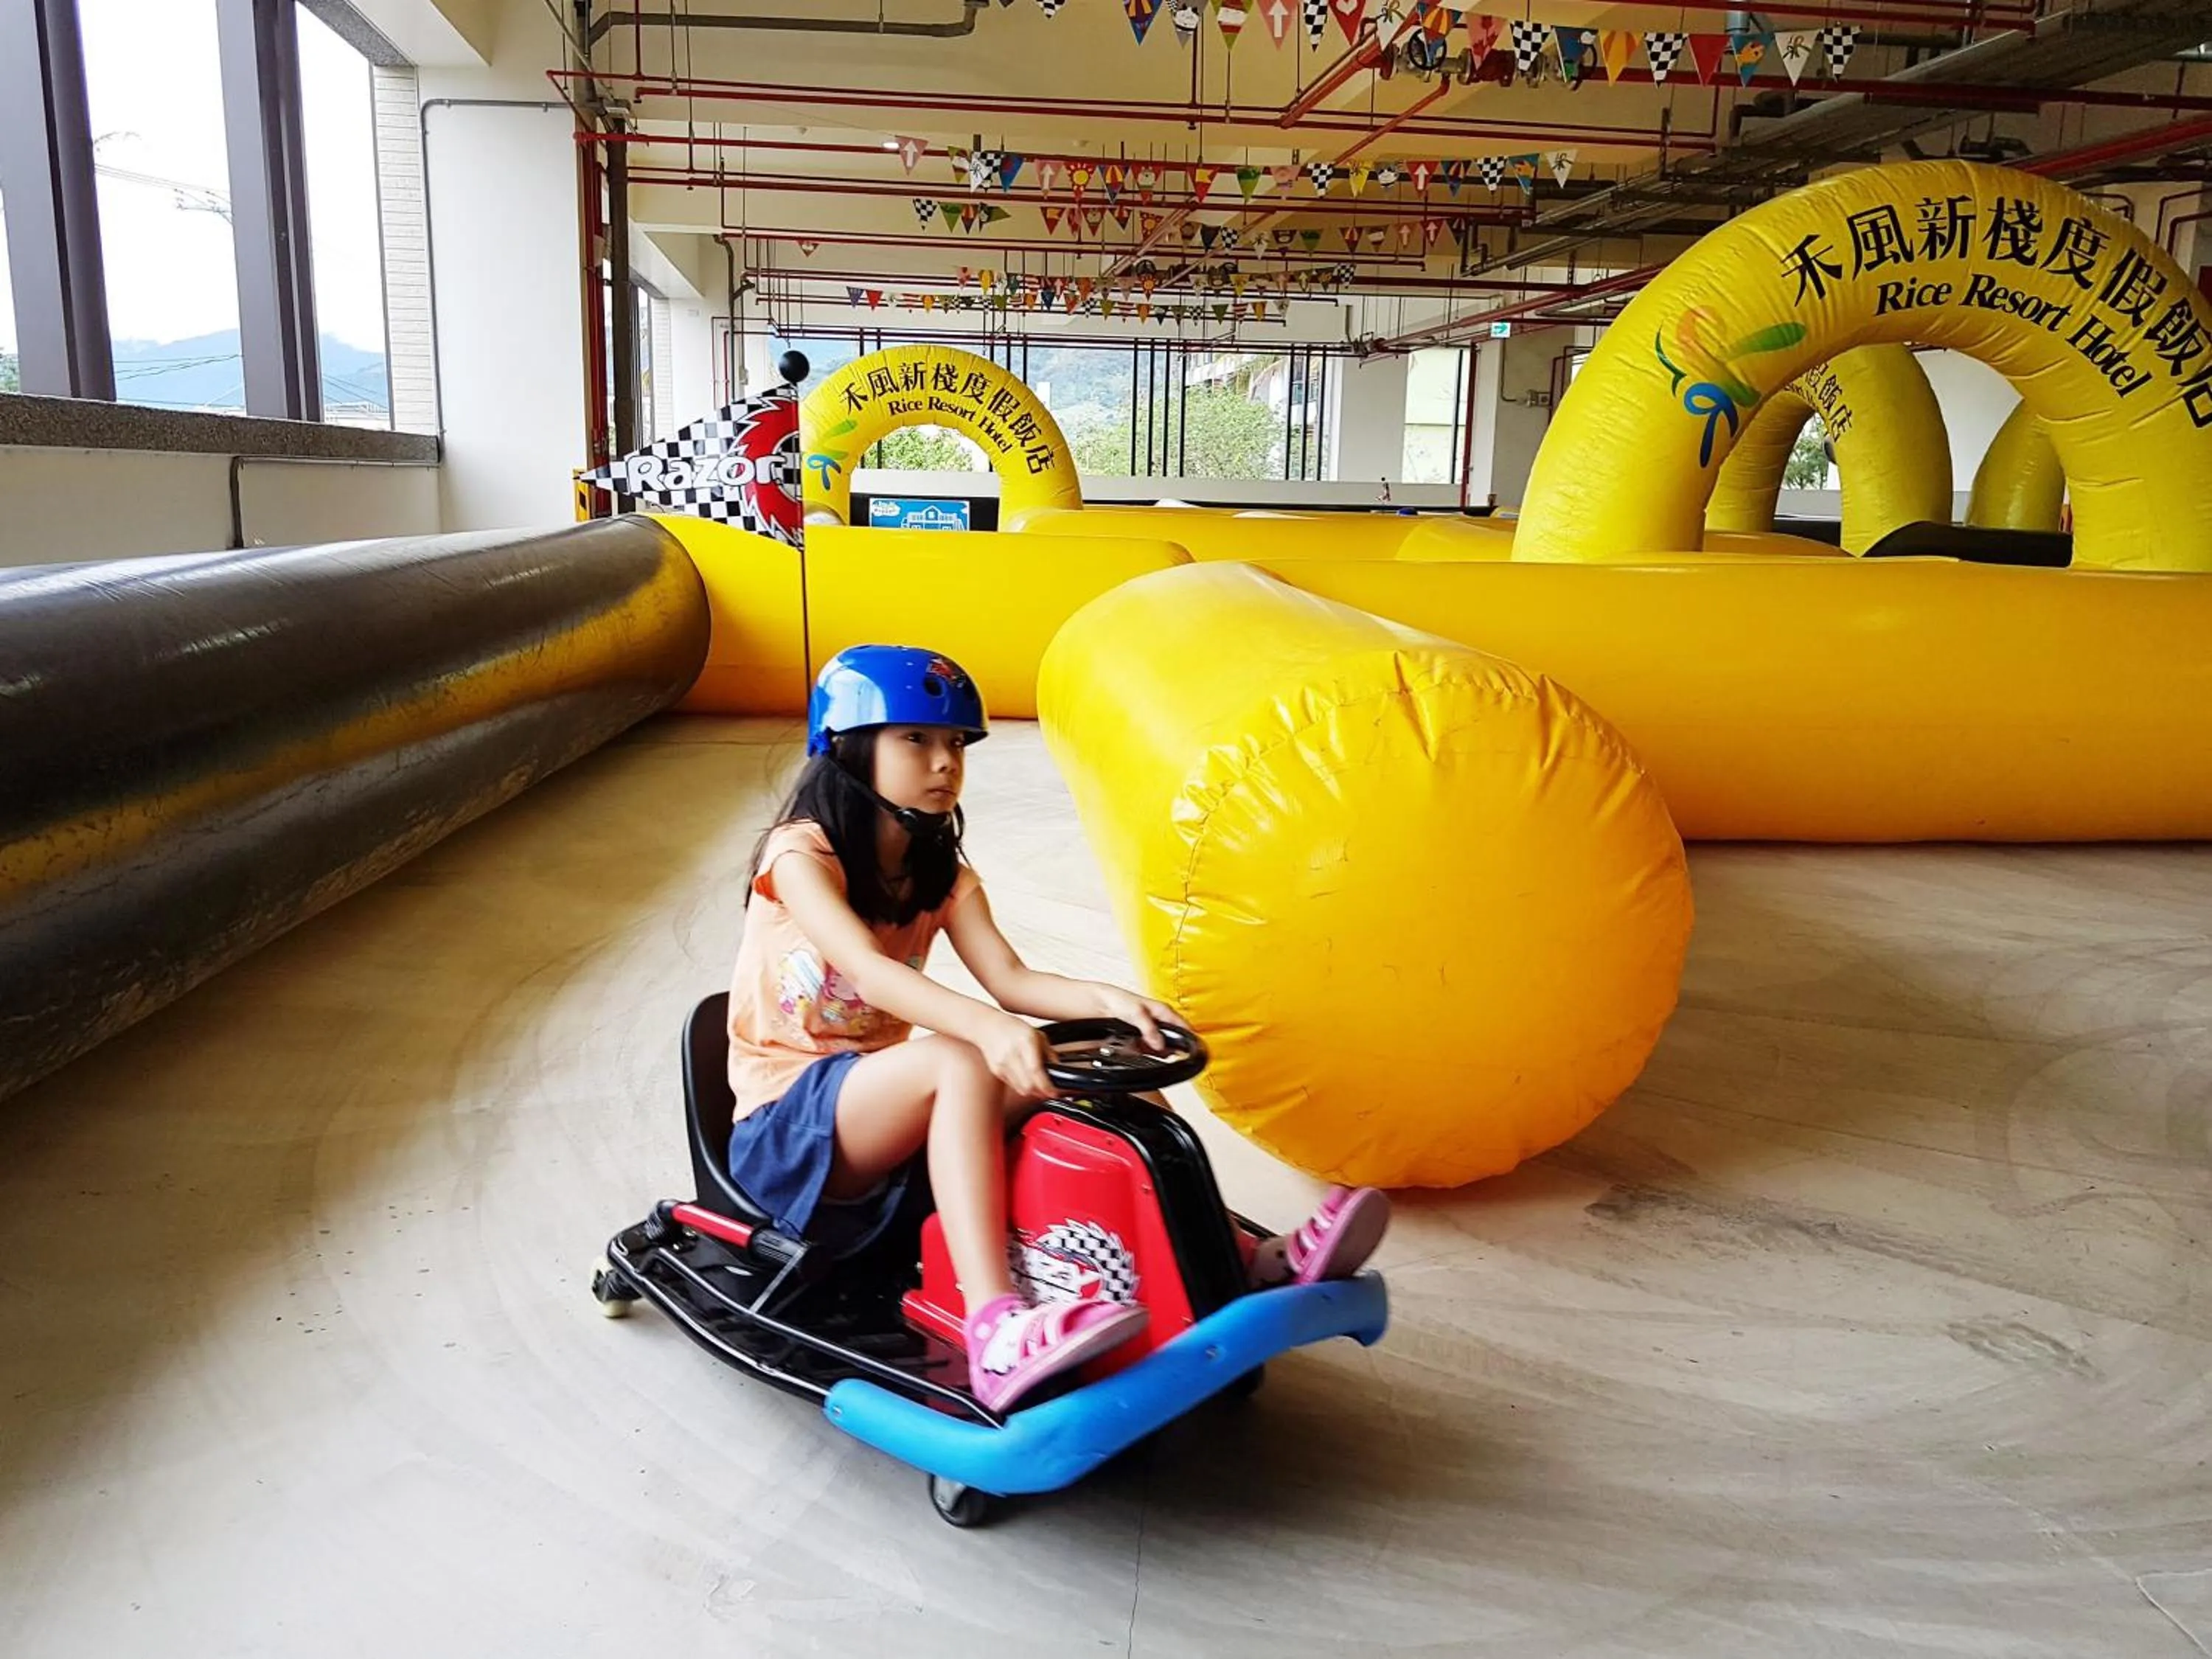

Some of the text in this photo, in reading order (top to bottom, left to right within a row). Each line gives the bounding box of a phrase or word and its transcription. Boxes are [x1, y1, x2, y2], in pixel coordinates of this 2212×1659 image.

[1875, 273, 2152, 399] Rice Resort Hotel
[839, 361, 1055, 475] 禾風新棧度假飯店
[888, 395, 1013, 454] Rice Resort Hotel
[625, 453, 787, 495] Razor
